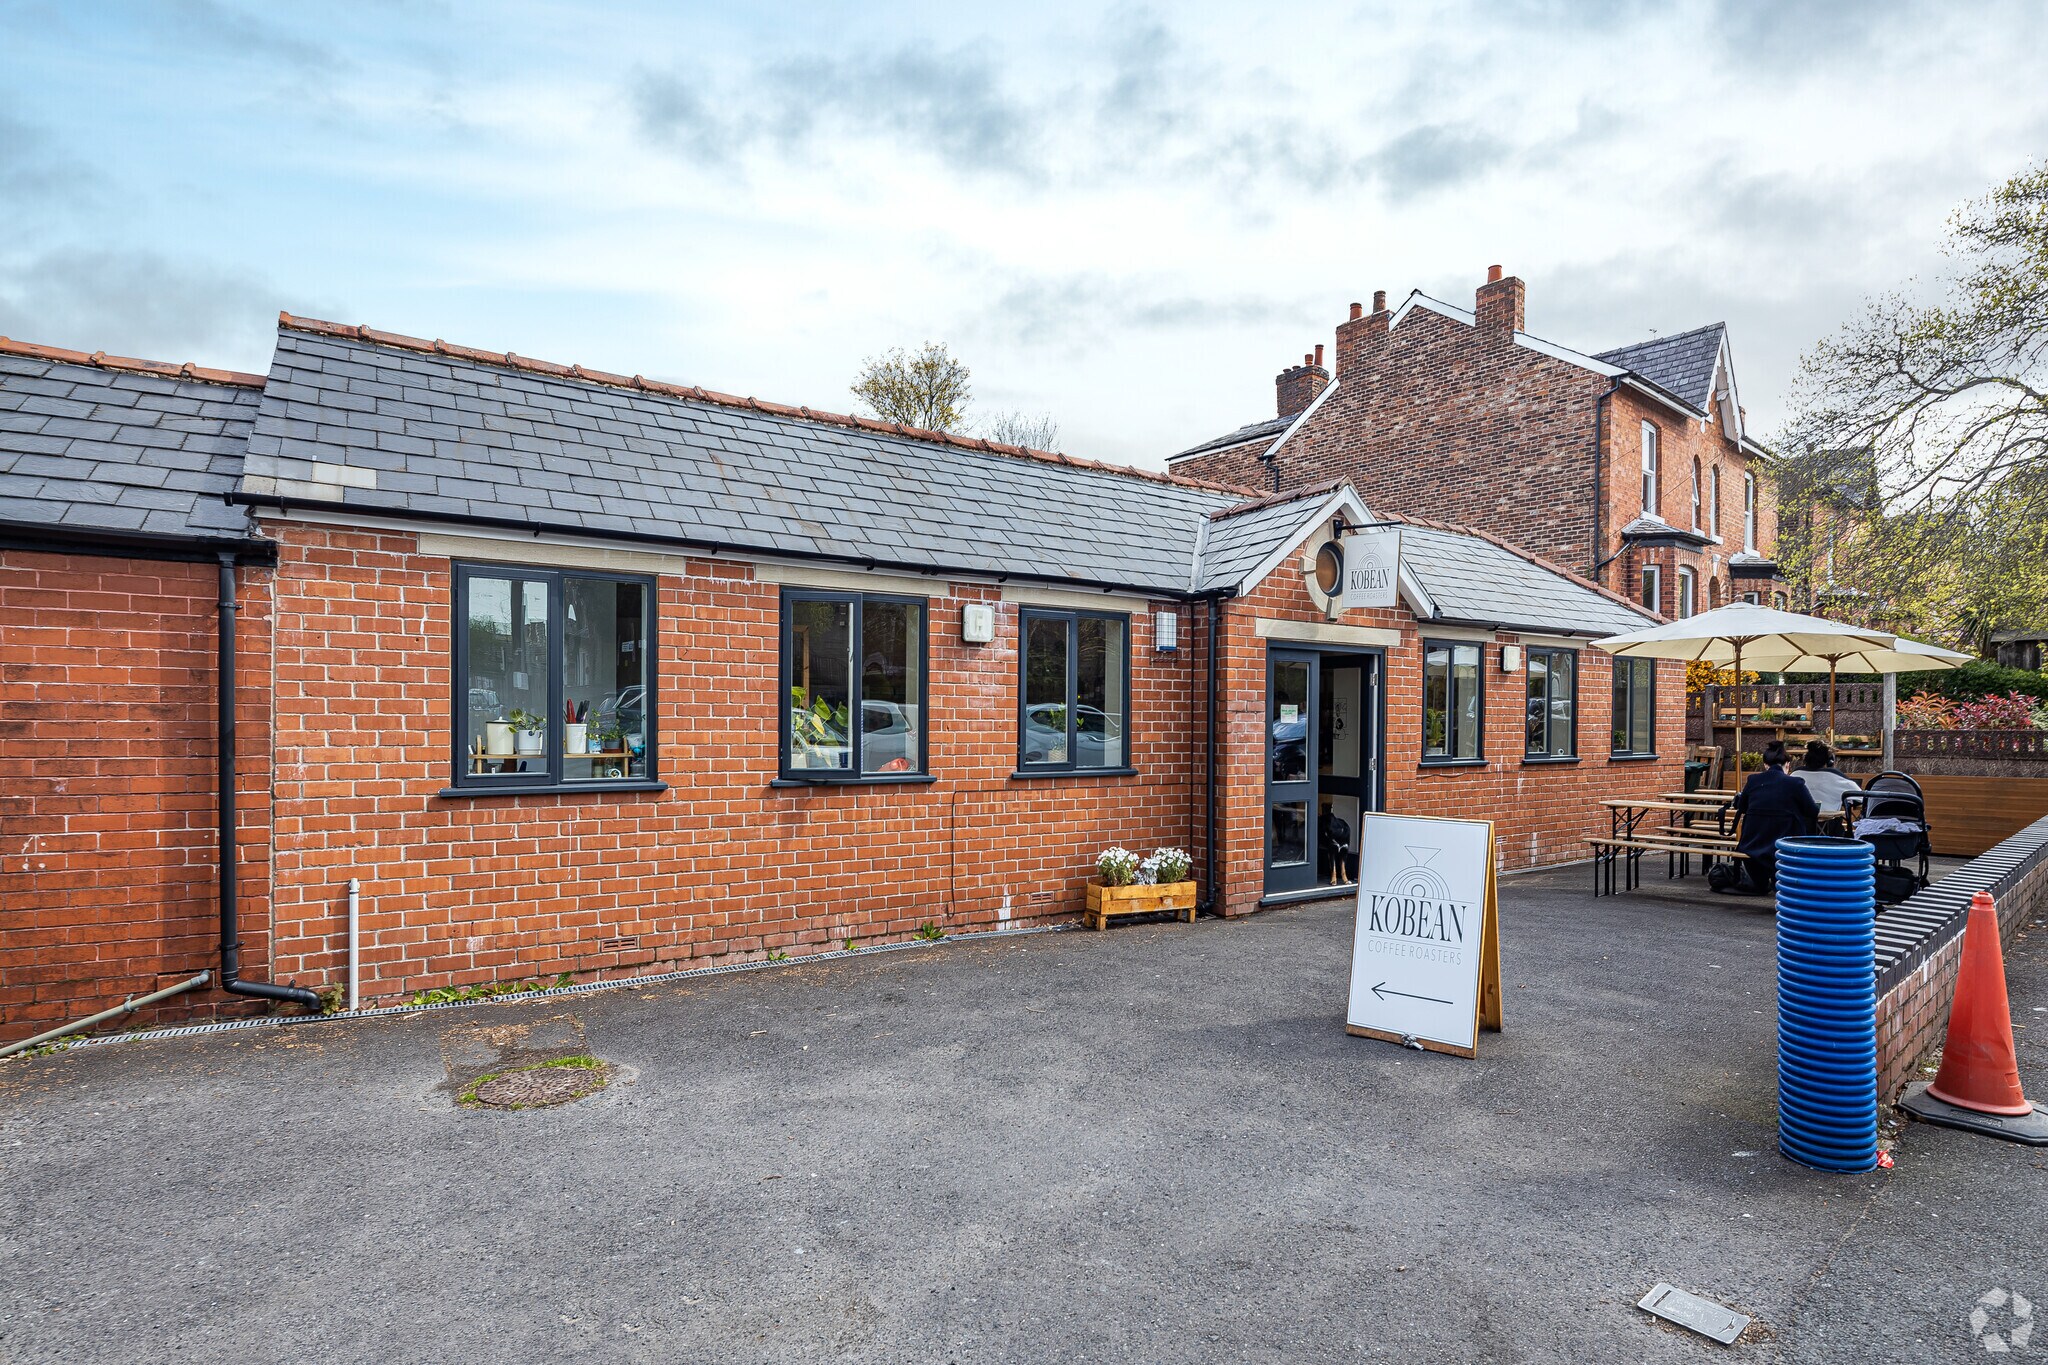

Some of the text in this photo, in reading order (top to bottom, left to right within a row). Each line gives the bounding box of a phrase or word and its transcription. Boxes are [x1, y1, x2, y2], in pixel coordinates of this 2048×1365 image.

[1350, 569, 1390, 590] KOBEAN
[1368, 894, 1467, 943] KOBEAN
[1368, 939, 1462, 965] COFFEE ROASTERS
